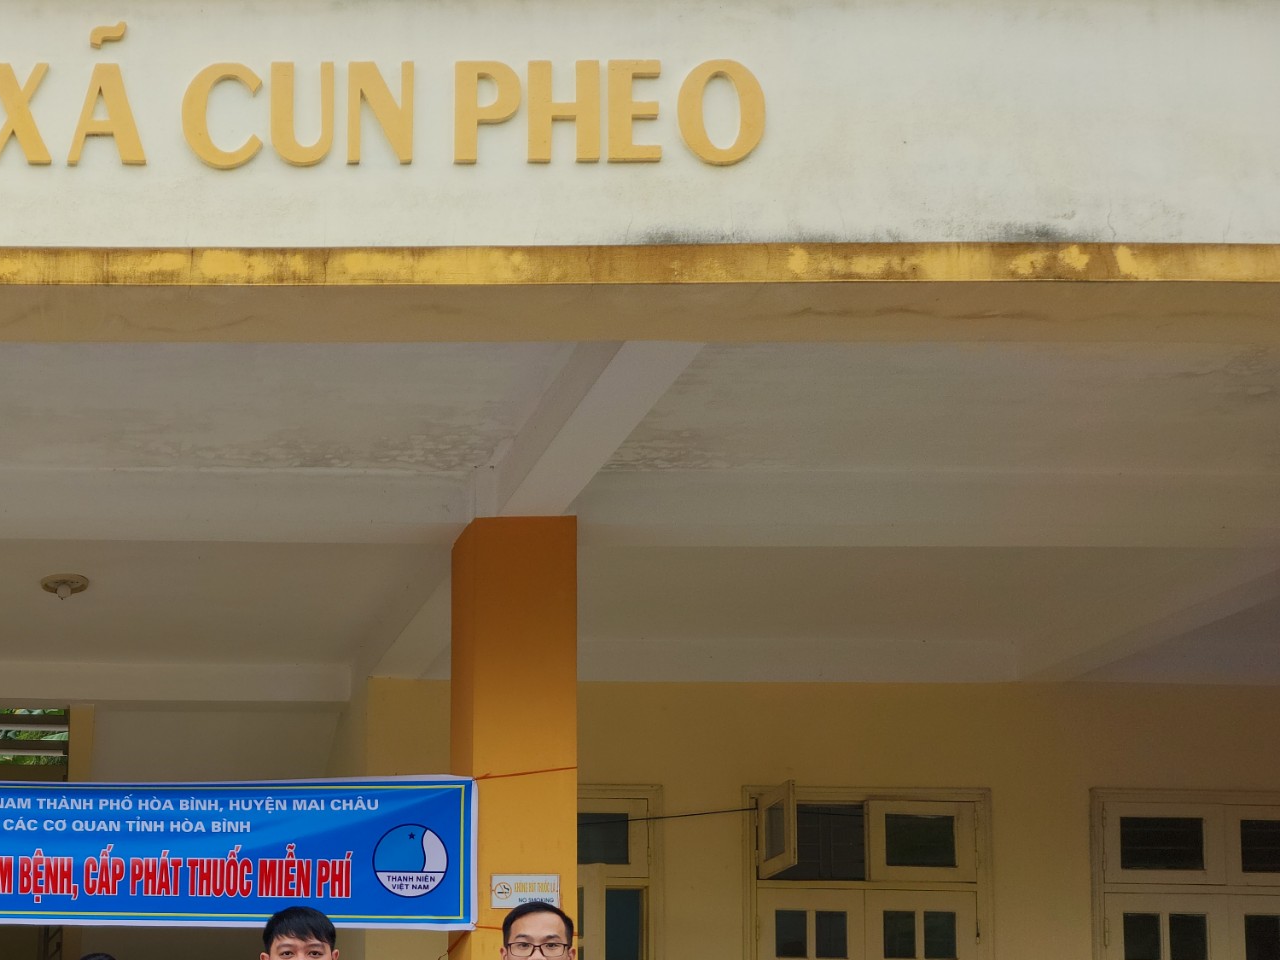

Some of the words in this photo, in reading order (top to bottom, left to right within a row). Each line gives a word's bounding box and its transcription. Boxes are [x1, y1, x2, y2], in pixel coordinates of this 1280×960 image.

[181, 60, 415, 169] CUN
[453, 58, 766, 167] PHEO
[37, 795, 94, 810] THÀNH
[98, 794, 133, 811] PHỐ
[138, 796, 174, 811] HÒA
[179, 796, 223, 812] BÌNH,
[229, 796, 287, 813] HUYỆN
[292, 799, 325, 811] MAI
[330, 796, 379, 811] CHÂU
[3, 817, 38, 831] CÁC
[43, 819, 67, 831] CƠ
[72, 820, 120, 832] QUAN
[125, 816, 165, 832] TỈNH
[169, 818, 206, 833] HÒA
[211, 818, 251, 833] BÌNH
[18, 848, 78, 903] BỆNH,
[84, 844, 125, 896] CẤP
[130, 850, 182, 897] PHÁT
[186, 845, 253, 897] THUỐC
[257, 843, 311, 898] MIỄN
[316, 851, 353, 898] PHÍ
[416, 874, 436, 882] NIÊN
[392, 882, 410, 891] VIỆT
